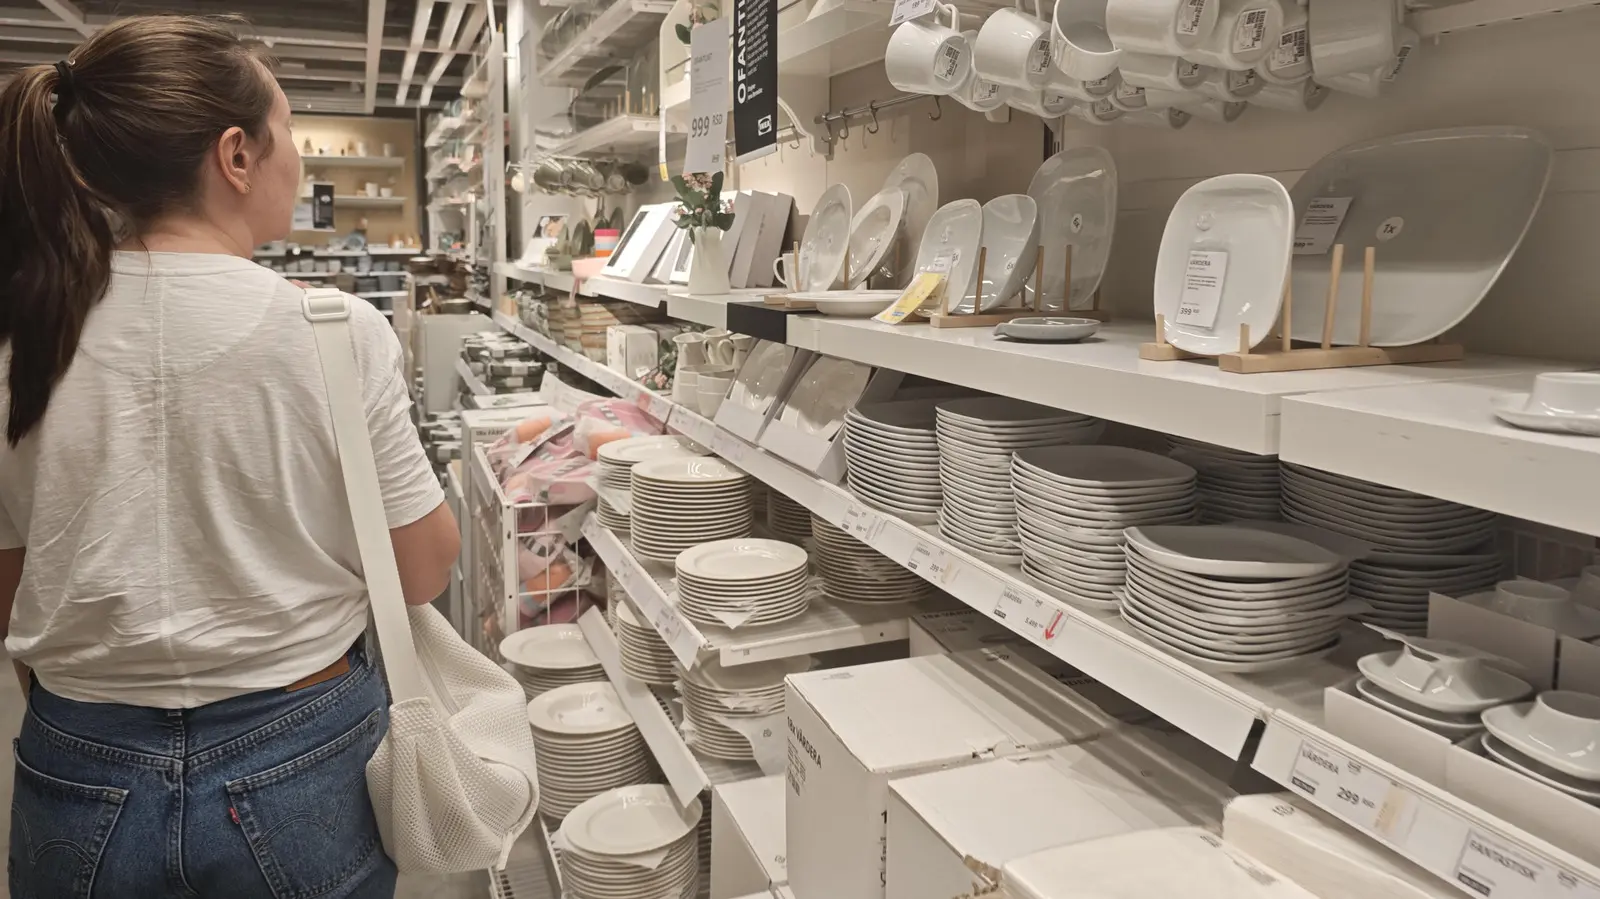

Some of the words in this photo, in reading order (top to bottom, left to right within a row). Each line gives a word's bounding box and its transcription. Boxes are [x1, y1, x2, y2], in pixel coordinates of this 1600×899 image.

[692, 116, 710, 138] 999
[786, 716, 796, 736] 18x
[795, 729, 823, 769] VÄRDERA
[1336, 785, 1360, 805] 299
